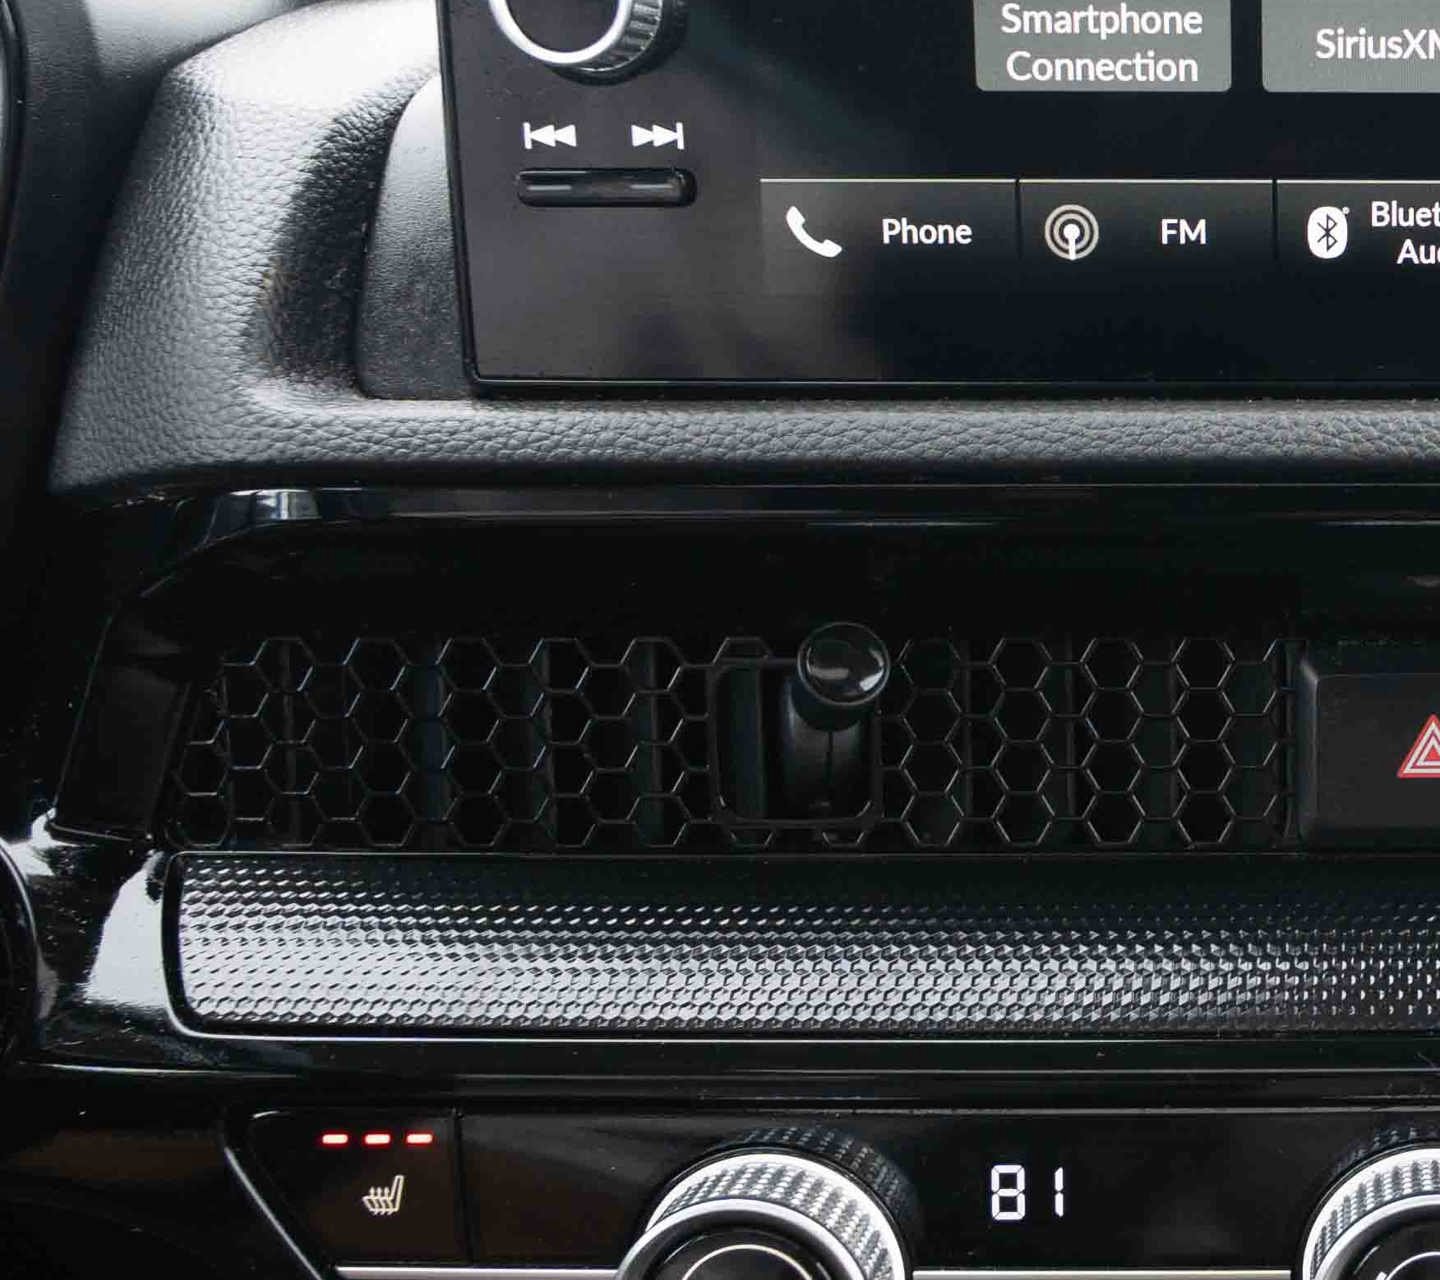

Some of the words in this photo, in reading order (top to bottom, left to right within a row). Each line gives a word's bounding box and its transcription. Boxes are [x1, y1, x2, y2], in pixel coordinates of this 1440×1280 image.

[1001, 2, 1203, 41] Smartphone
[1006, 49, 1199, 82] Connection
[882, 218, 973, 246] Phone
[1160, 219, 1207, 246] FM
[990, 1164, 1065, 1222] 81
